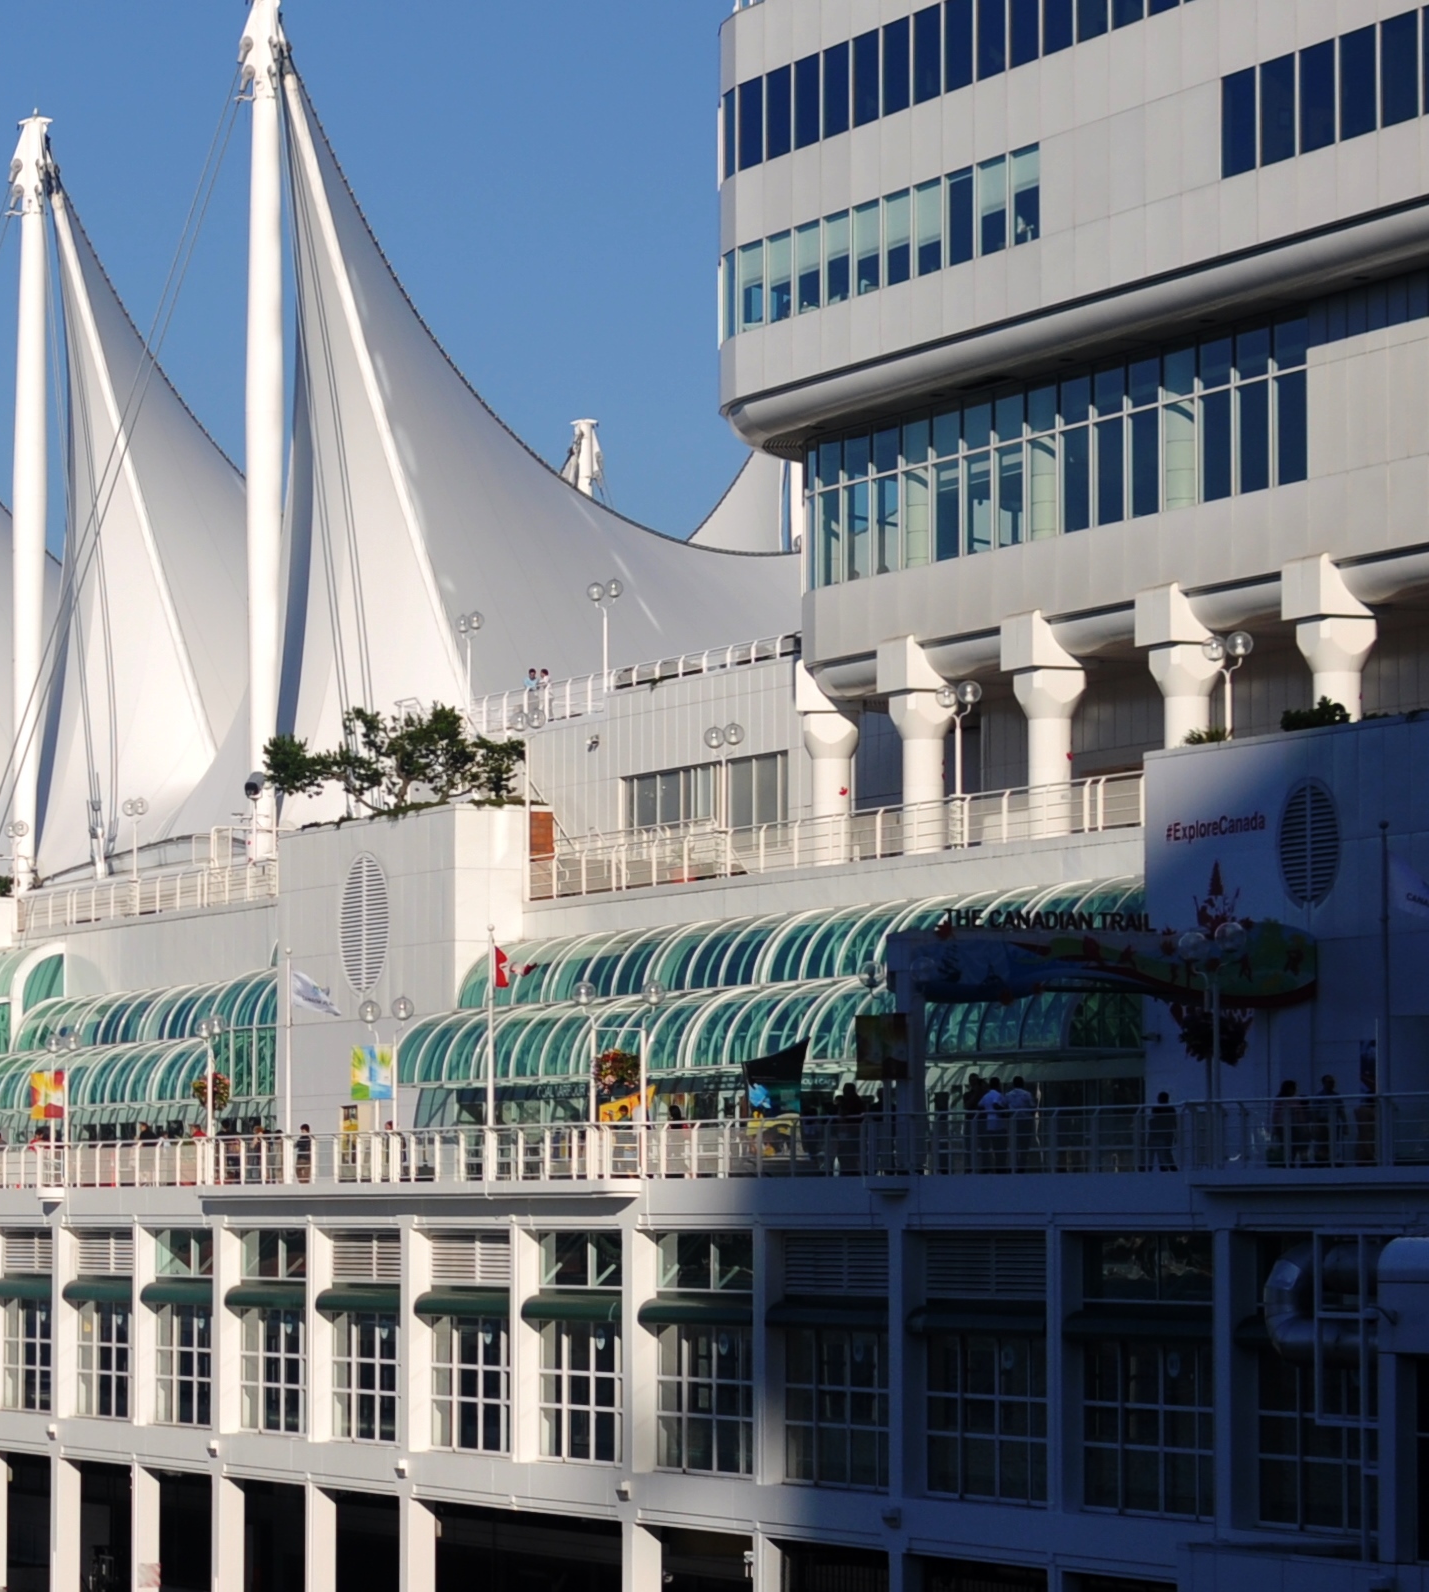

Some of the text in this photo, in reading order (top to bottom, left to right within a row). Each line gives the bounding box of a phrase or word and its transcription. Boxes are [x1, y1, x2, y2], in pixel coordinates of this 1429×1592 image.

[1165, 811, 1266, 843] #ExploreCanada
[944, 908, 1156, 932] THE CANADIAN TRAIL
